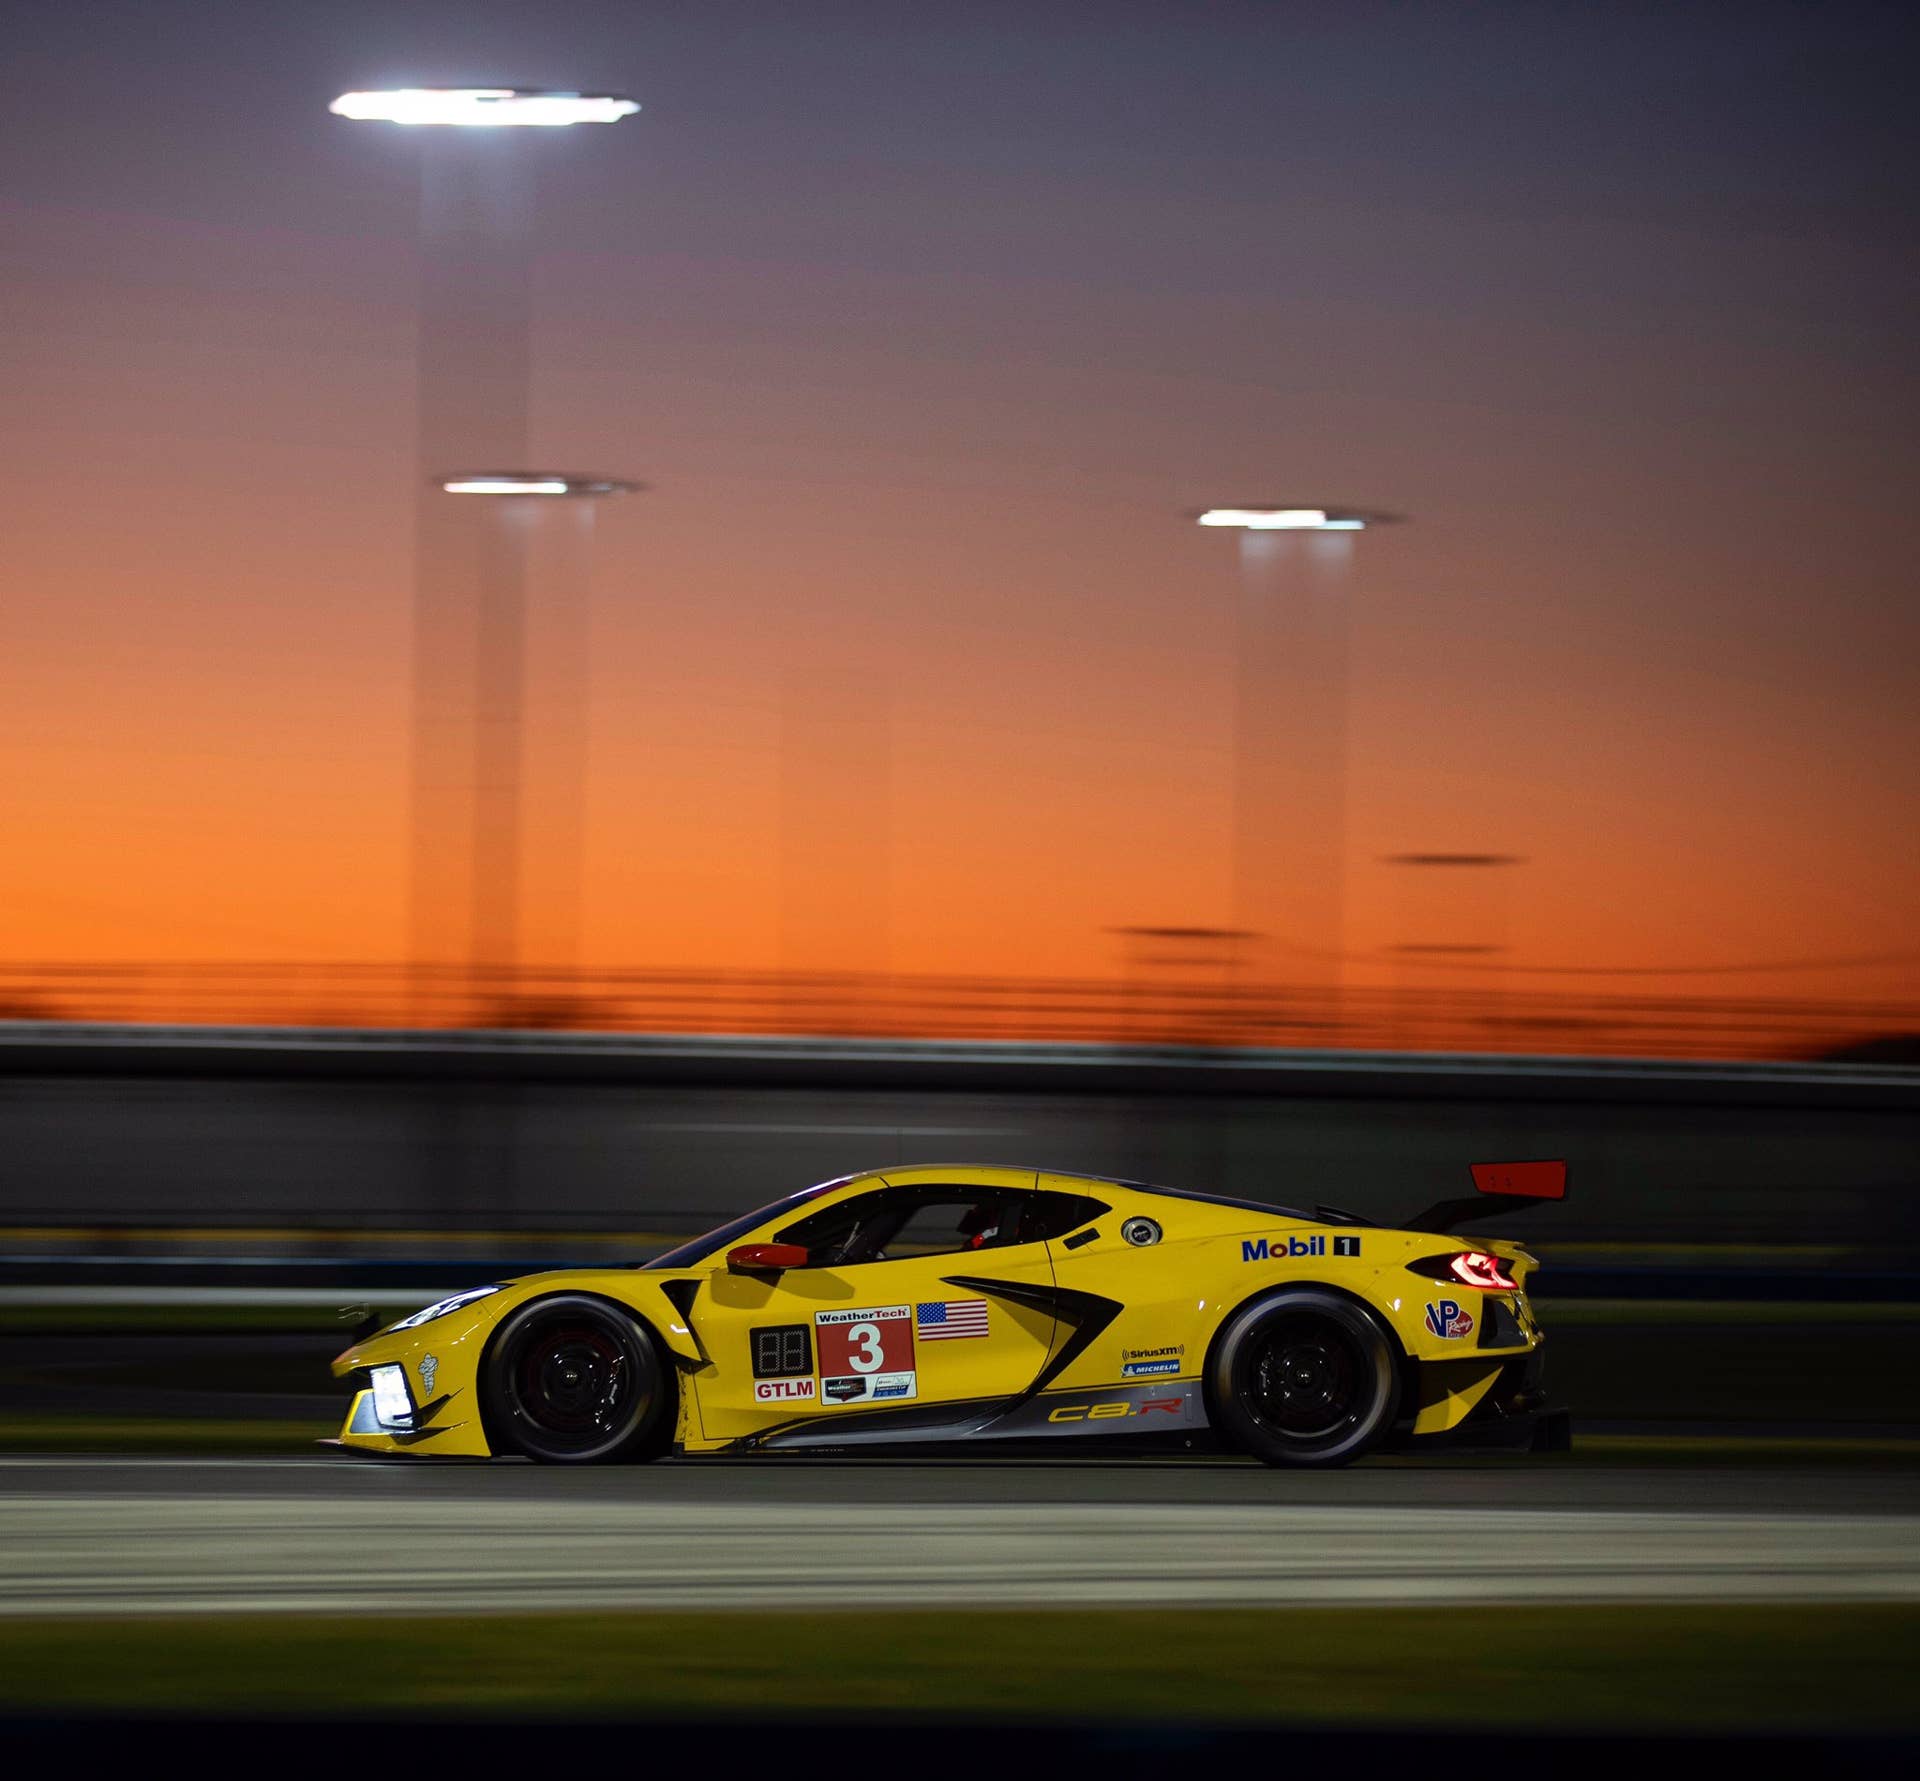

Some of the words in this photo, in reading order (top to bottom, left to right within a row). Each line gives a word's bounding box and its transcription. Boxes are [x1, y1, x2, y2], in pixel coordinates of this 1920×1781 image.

[1242, 1236, 1325, 1262] Mobil
[819, 1309, 906, 1322] WeatherTech
[1426, 1300, 1460, 1338] VP
[848, 1323, 884, 1373] 3
[1136, 1363, 1179, 1374] MICHELIN
[757, 1381, 813, 1398] GTLM
[1048, 1398, 1183, 1422] C8.R
